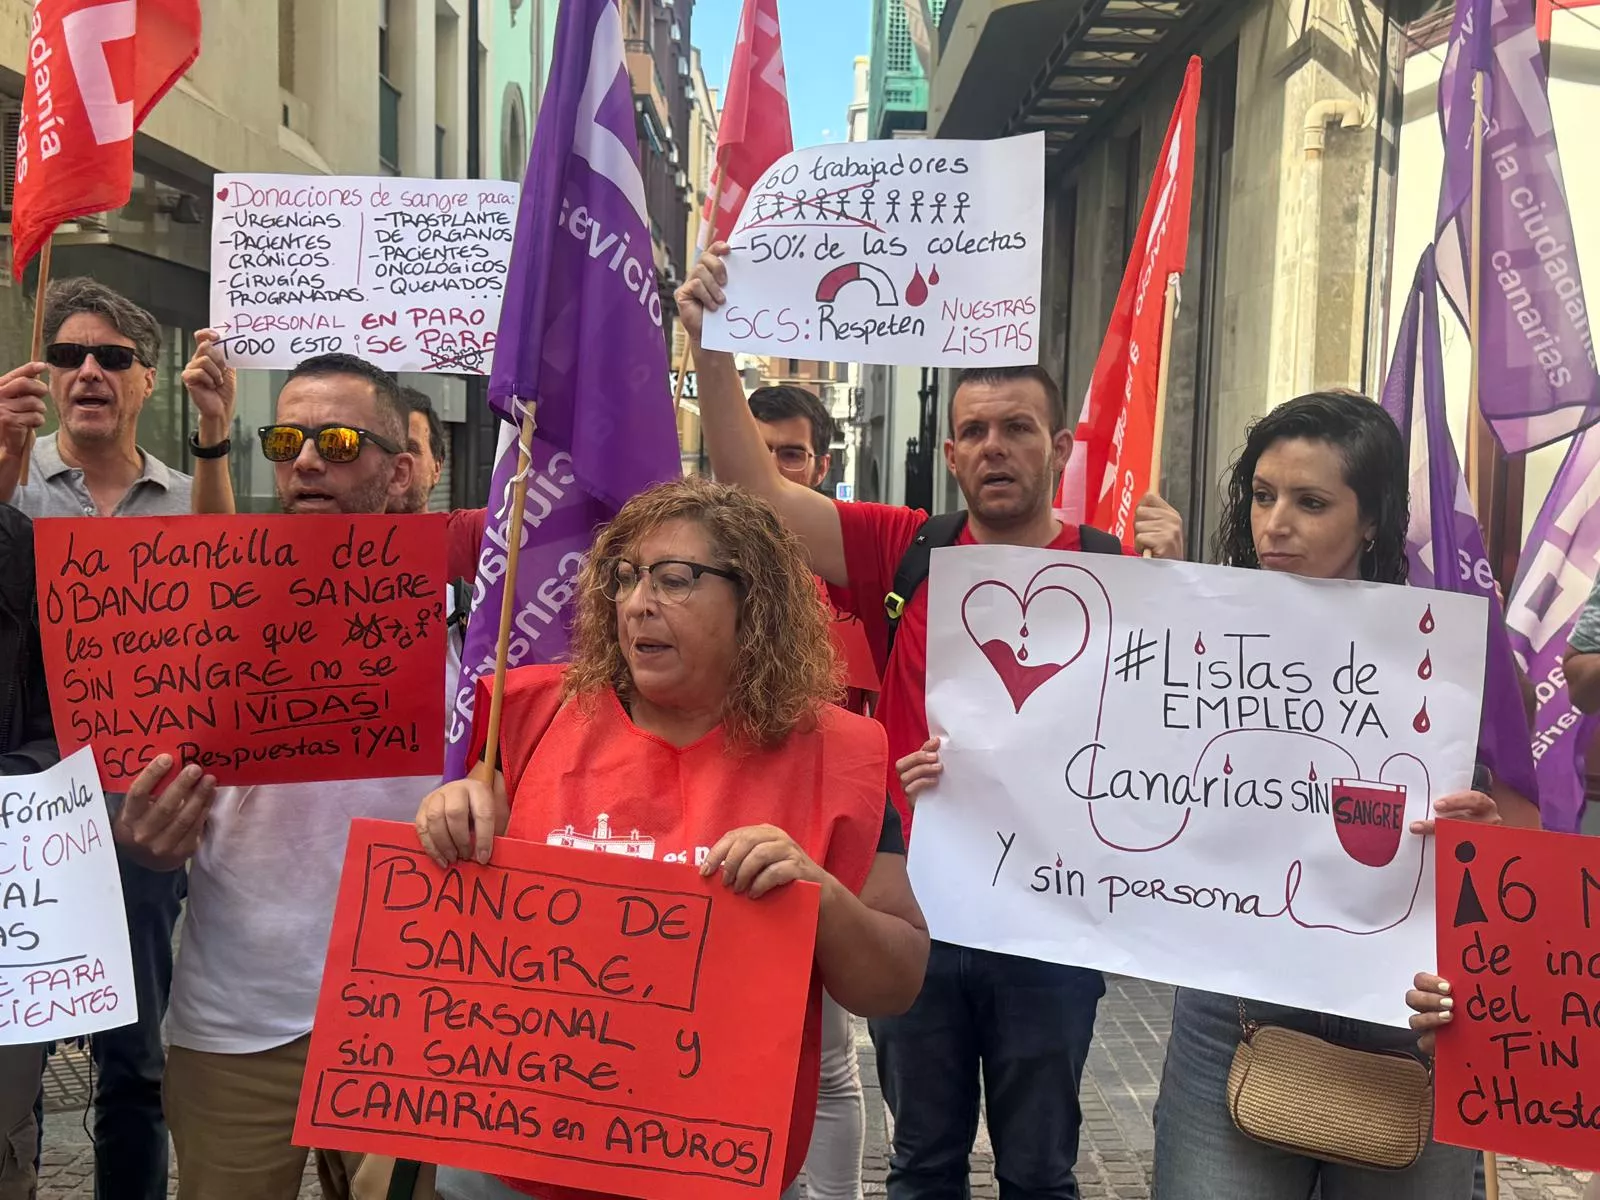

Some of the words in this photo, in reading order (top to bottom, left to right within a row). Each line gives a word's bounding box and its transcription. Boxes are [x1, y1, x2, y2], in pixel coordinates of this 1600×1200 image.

[31, 0, 65, 161] adanía
[808, 153, 969, 184] trabajadores
[1491, 142, 1519, 180] la
[229, 181, 363, 208] Donaciones
[370, 183, 391, 207] de
[401, 191, 469, 214] sangre
[374, 229, 405, 243] DE
[813, 231, 846, 260] de
[862, 231, 908, 257] las
[926, 229, 1027, 255] colectas
[233, 313, 346, 334] PERSONAL
[361, 310, 398, 330] EN
[405, 307, 486, 328] PARO
[724, 305, 811, 343] SCS:
[817, 303, 926, 345] Respeten
[940, 295, 1037, 321] NUESTRAS
[1491, 249, 1572, 388] canarias
[213, 333, 276, 360] TODO
[290, 335, 343, 353] ESTO
[415, 329, 498, 351] PARA
[60, 531, 110, 578] La
[128, 527, 299, 584] plantilla
[331, 524, 401, 570] del
[67, 580, 190, 624] BANCO
[209, 580, 262, 610] DE
[289, 573, 438, 608] SANGRE
[65, 627, 103, 663] les
[112, 620, 240, 656] recuerda
[261, 619, 320, 656] que
[132, 654, 294, 700] SANGRE
[309, 660, 343, 683] no
[358, 655, 400, 679] se
[1331, 640, 1380, 695] de
[71, 695, 217, 743] SALVAN
[1162, 693, 1326, 733] EMPLEO
[1339, 699, 1390, 739] YA
[103, 743, 157, 780] SCS
[176, 736, 341, 772] Respuestas
[350, 721, 421, 760] ¡YA!
[0, 777, 93, 829] fórmula
[1064, 743, 1285, 812] Canarias
[1333, 794, 1404, 831] SANGRE
[0, 877, 59, 911] AL
[1030, 852, 1086, 898] sin
[373, 856, 583, 927] BANCO
[616, 895, 693, 941] DE
[398, 919, 656, 999] SANGRE,
[1461, 930, 1512, 976] de
[22, 957, 106, 996] PARA
[418, 985, 637, 1052] PERSONAL
[1465, 983, 1532, 1025] del
[337, 1032, 395, 1069] sin
[552, 1115, 586, 1143] en
[604, 1115, 760, 1176] APUROS
